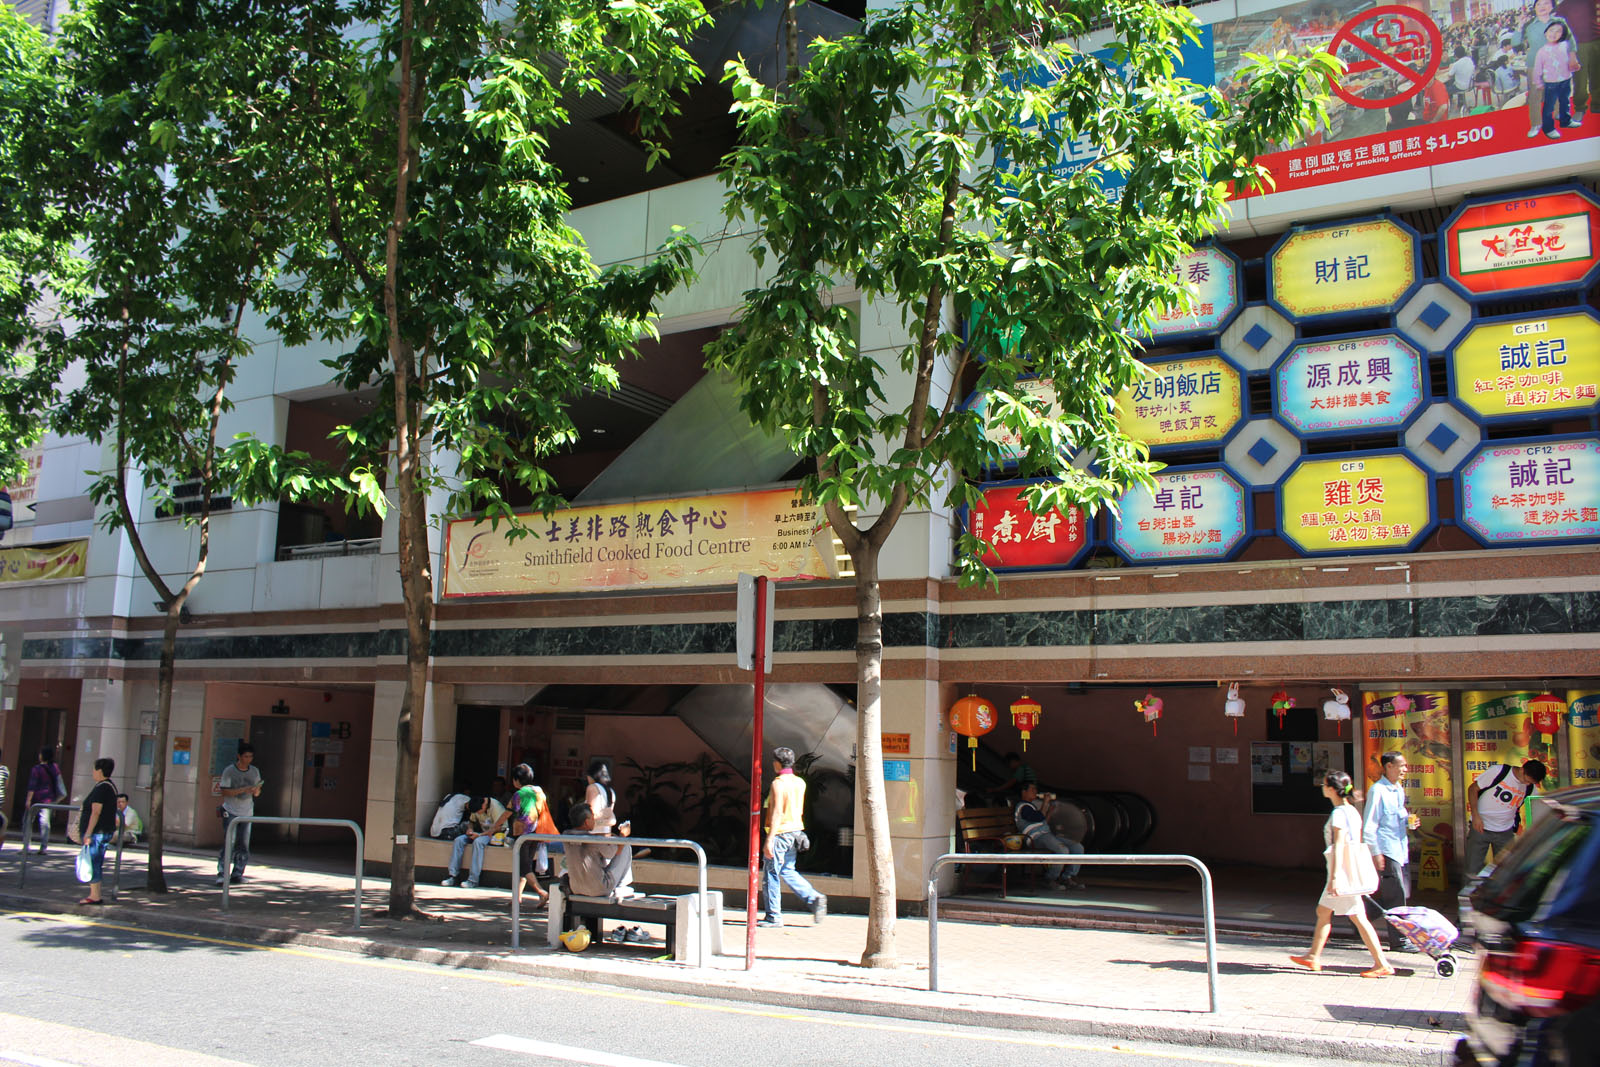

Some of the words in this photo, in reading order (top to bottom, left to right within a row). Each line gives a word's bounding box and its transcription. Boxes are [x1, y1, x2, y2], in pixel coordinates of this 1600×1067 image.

[1426, 126, 1494, 152] $1,500
[1289, 169, 1309, 178] Fixed
[1312, 165, 1340, 176] penalty
[1356, 155, 1390, 167] smoking
[1392, 150, 1422, 161] offence
[1505, 202, 1520, 212] CF
[1524, 200, 1537, 208] 10
[1331, 229, 1350, 238] CF7
[1528, 255, 1558, 263] MARKET
[1315, 255, 1371, 284] 財記
[1515, 325, 1530, 334] CF
[1535, 323, 1546, 332] 11
[1338, 343, 1357, 351] CF8
[1499, 339, 1567, 370] 誠記
[1166, 363, 1183, 371] CF5
[1307, 357, 1392, 388] 源成興
[1131, 370, 1221, 402] 友明飯店
[1474, 371, 1562, 393] 紅茶咖啡
[1135, 400, 1192, 418] 街坊小菜
[1160, 415, 1217, 433] 晚飯宵夜
[1341, 463, 1355, 471] CF
[1358, 462, 1364, 470] 9
[1508, 458, 1574, 488] 誠記
[1169, 475, 1186, 483] CF6
[1153, 485, 1204, 511] 卓記
[1492, 490, 1565, 509] 紅茶咖啡
[777, 528, 810, 536] Business
[524, 546, 593, 567] Smithfield
[597, 543, 651, 562] Cooked
[655, 540, 693, 559] Food
[698, 538, 751, 556] Centre
[772, 542, 788, 550] 6:00
[790, 541, 801, 549] AM
